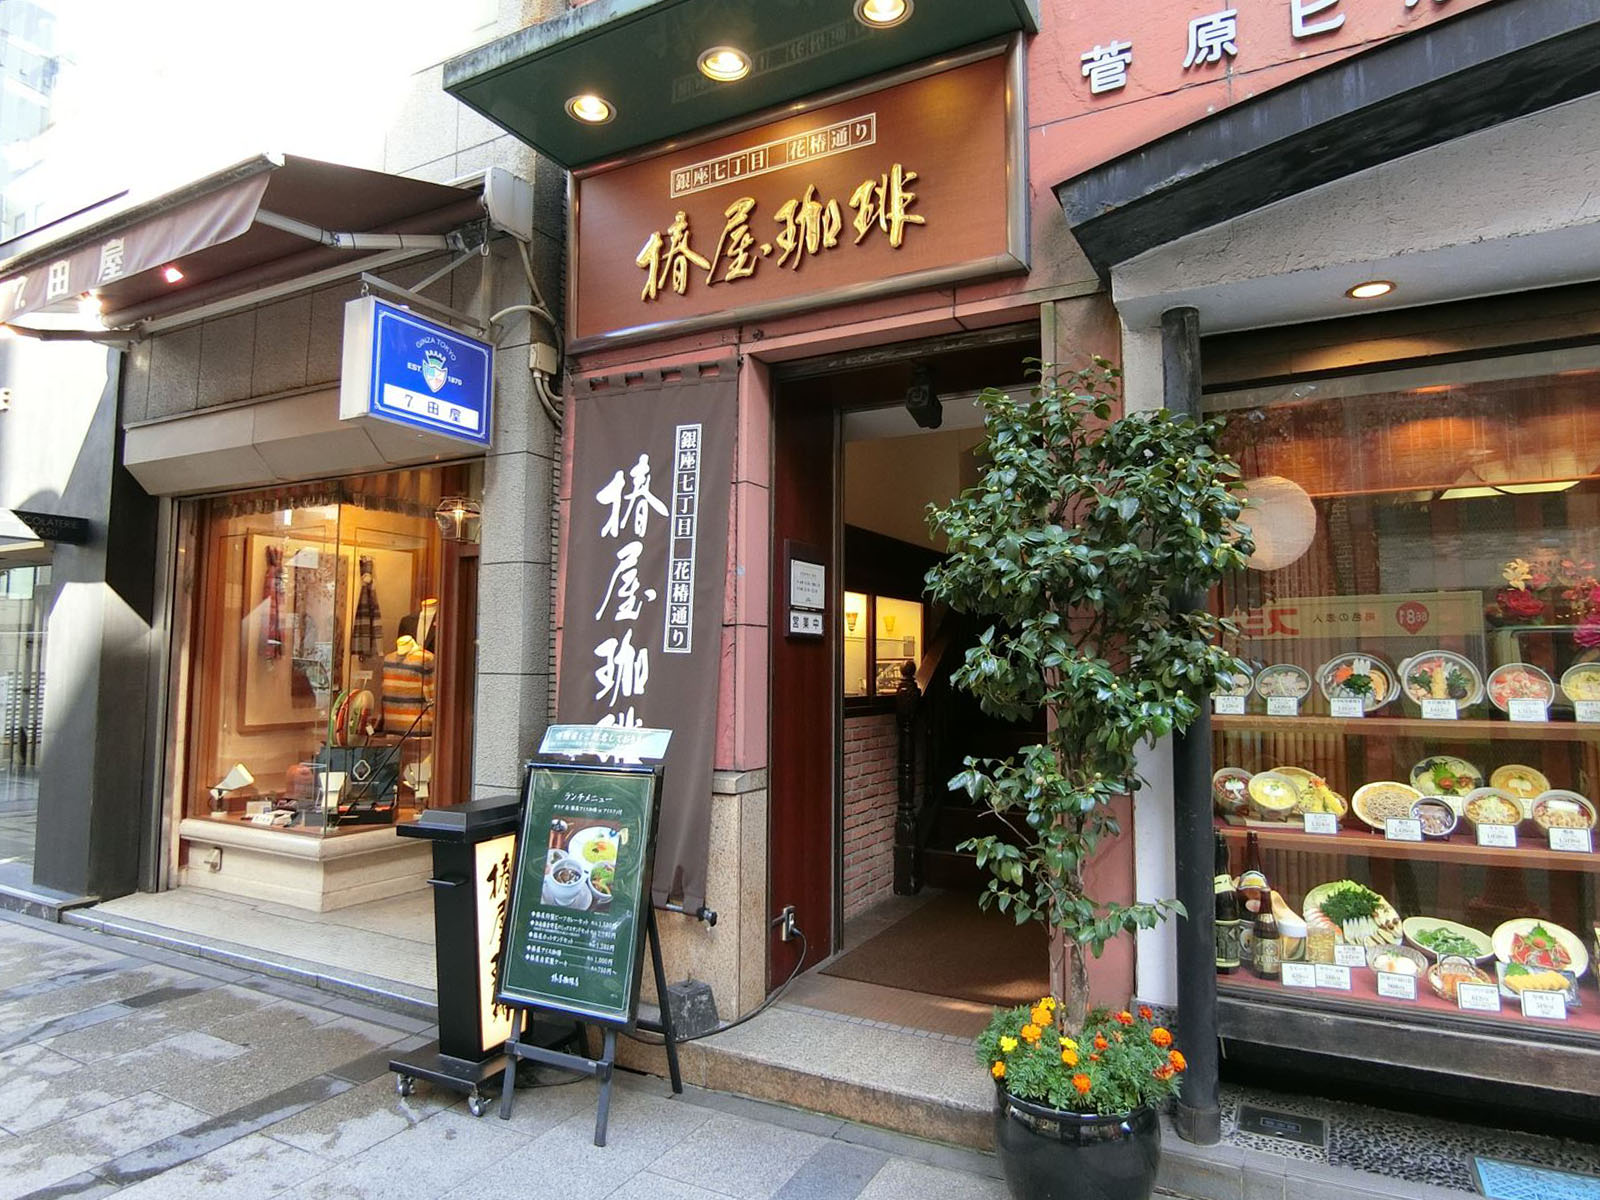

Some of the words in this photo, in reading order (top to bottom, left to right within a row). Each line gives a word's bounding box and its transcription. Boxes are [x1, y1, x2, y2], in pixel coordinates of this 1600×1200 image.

[1081, 0, 1447, 94] 菅原ビ
[674, 148, 767, 192] 銀座七丁目
[789, 120, 873, 159] 花椿通り
[415, 336, 436, 349] GINZA
[437, 338, 457, 361] TOKYO
[674, 430, 698, 537] 銀座七丁目
[670, 561, 692, 647] 花椿通り
[791, 615, 821, 631] 営業中
[564, 791, 614, 803] ランチメニュー
